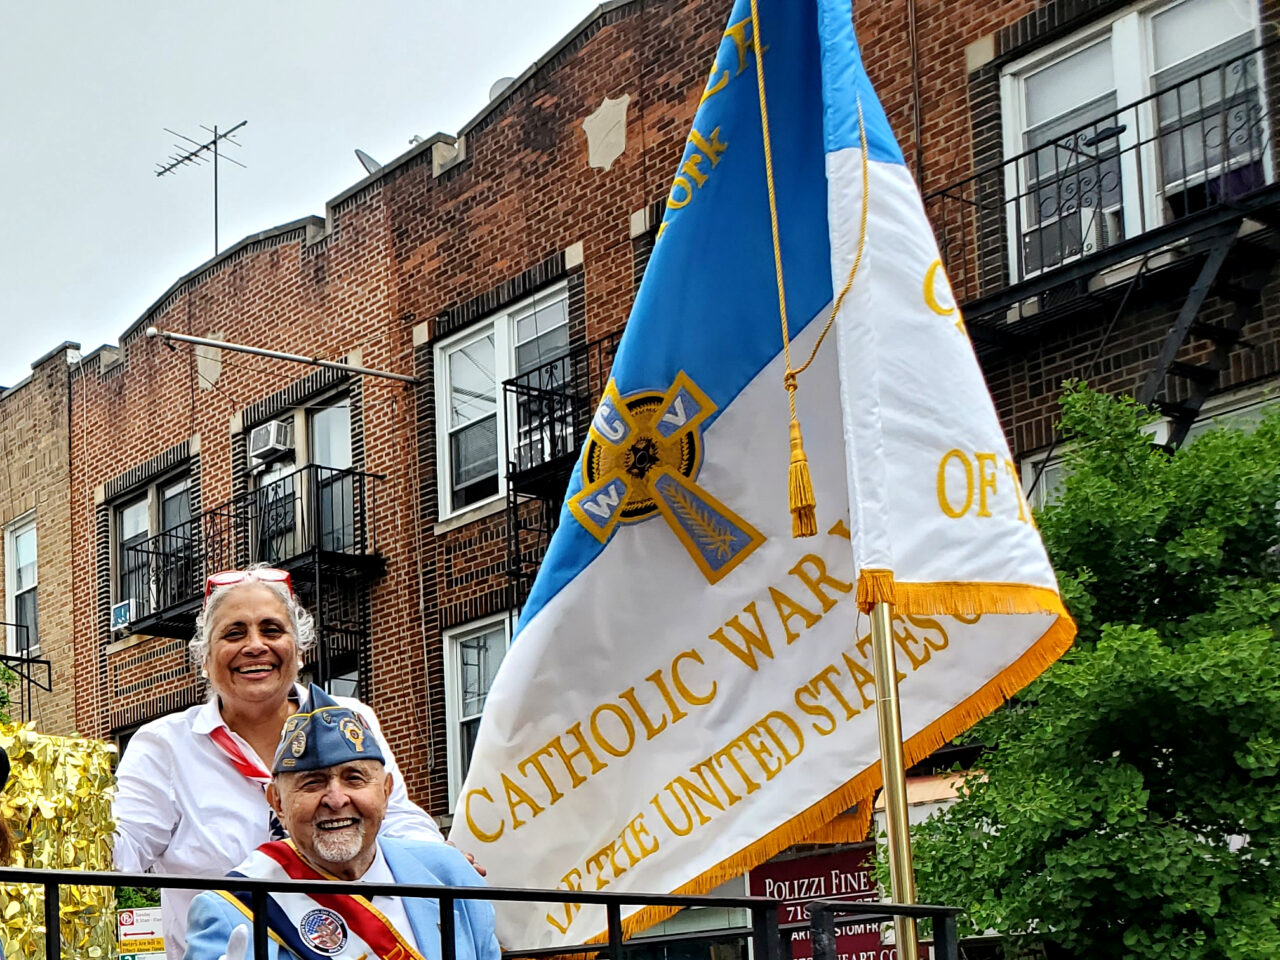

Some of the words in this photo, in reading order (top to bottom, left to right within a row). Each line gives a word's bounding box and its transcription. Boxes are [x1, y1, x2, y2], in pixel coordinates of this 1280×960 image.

[937, 448, 998, 519] OF
[464, 649, 718, 843] CATHOLIC
[708, 552, 853, 672] WAR
[585, 811, 660, 890] THE
[650, 709, 806, 838] UNITED
[764, 876, 826, 900] POLIZZI
[830, 869, 870, 895] FINE
